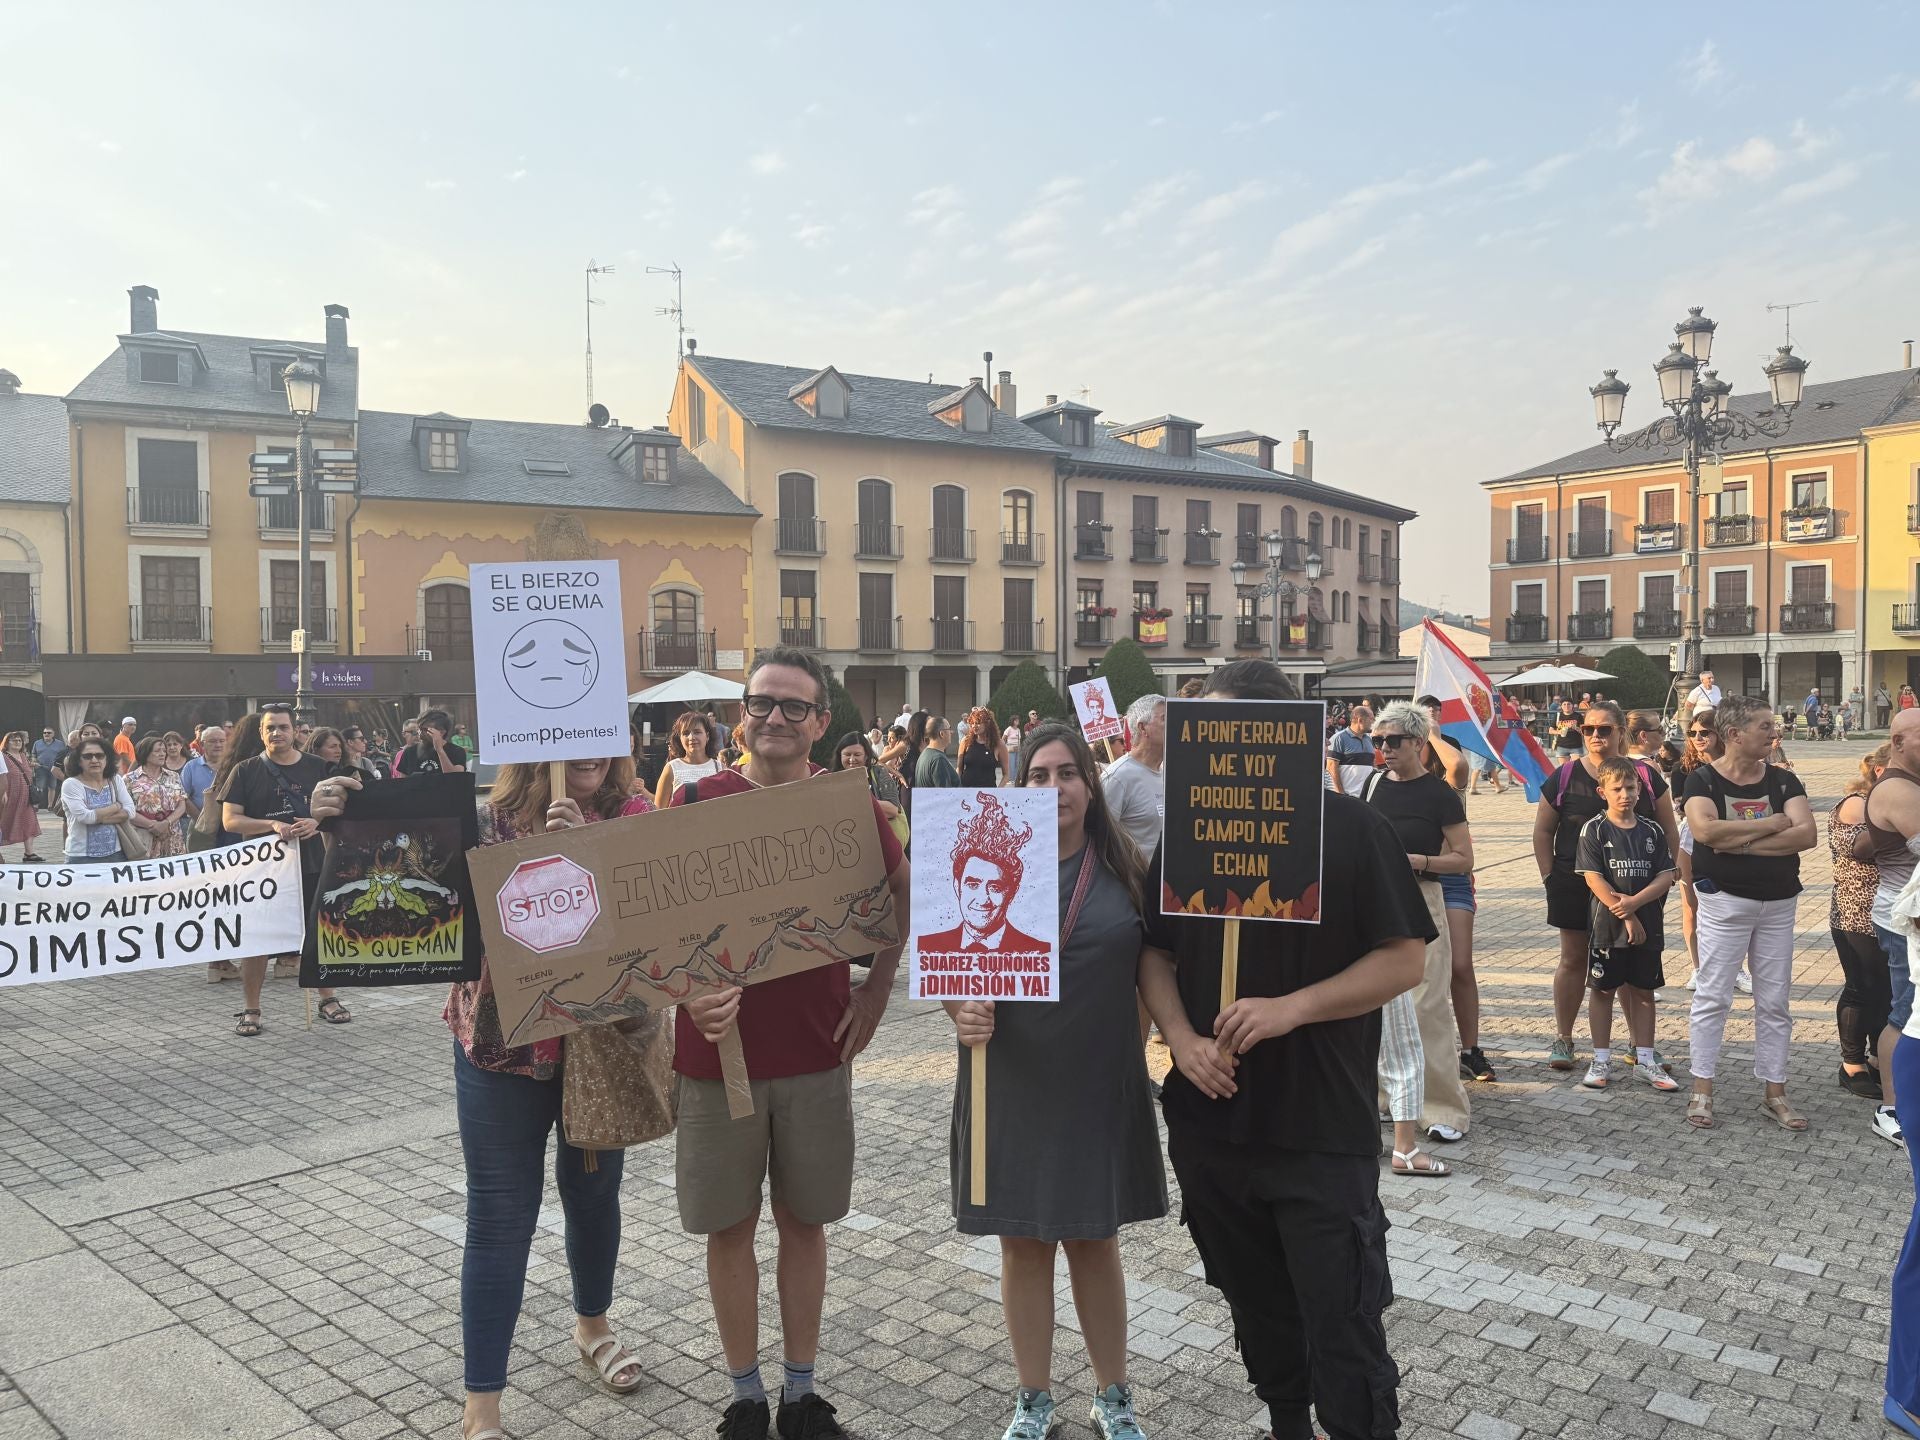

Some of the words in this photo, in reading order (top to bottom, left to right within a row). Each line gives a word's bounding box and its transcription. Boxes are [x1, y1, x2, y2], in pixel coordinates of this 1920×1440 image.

[491, 574, 516, 589] EL
[522, 571, 599, 588] BIERZO
[492, 596, 519, 611] SE
[526, 593, 604, 611] QUEMA
[492, 725, 618, 746] ¡Incomppetentes!
[1181, 720, 1191, 742] A
[1197, 720, 1308, 745] PONFERRADA
[1209, 753, 1238, 776] ME
[1244, 754, 1276, 777] VOY
[1190, 785, 1256, 810] PORQUE
[1261, 787, 1295, 811] DEL
[1194, 818, 1255, 843] CAMPO
[1260, 821, 1290, 845] ME
[111, 840, 288, 883] MENTIROSOS
[613, 818, 861, 919] INCENDIOS
[1213, 852, 1269, 877] ECHAN
[1609, 858, 1652, 869] Emirates
[1617, 869, 1627, 877] FLY
[101, 878, 277, 918] AUTONÓMICO
[508, 884, 590, 922] STOP
[322, 930, 359, 958] NOS
[372, 924, 458, 957] QUEMAN
[919, 971, 1016, 997] ¡DIMISIÓN
[1020, 975, 1050, 996] YA!
